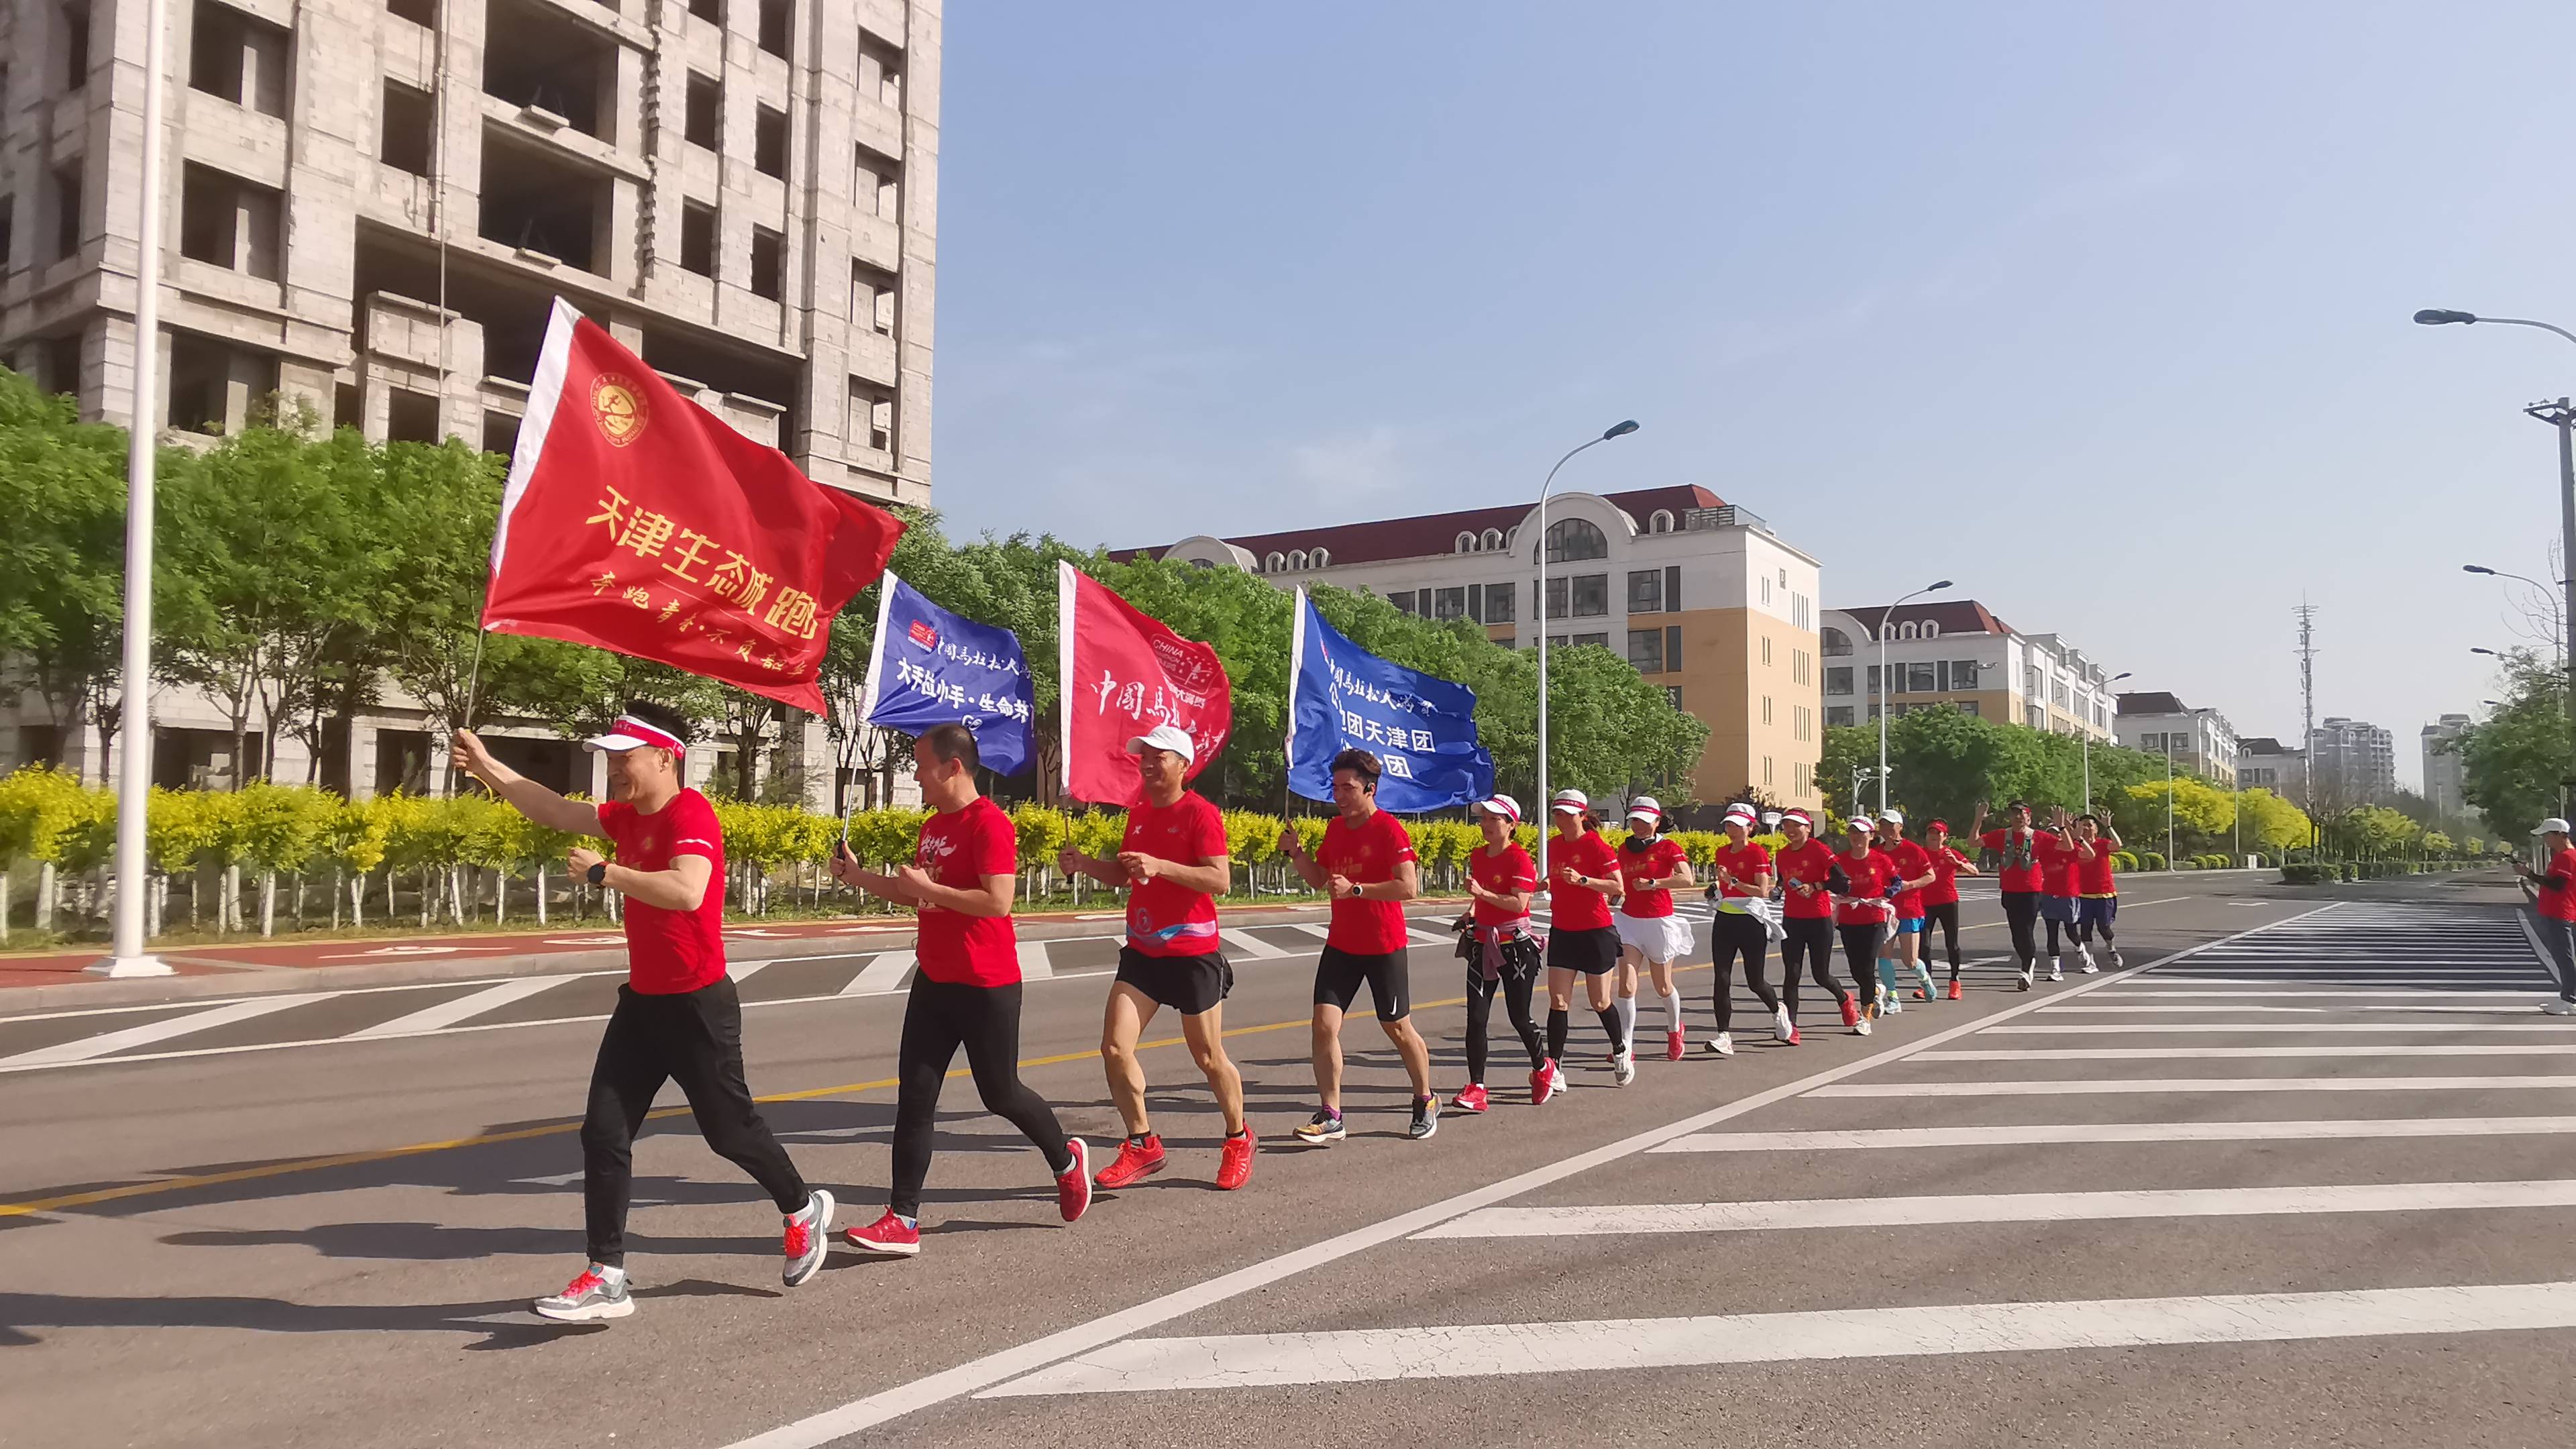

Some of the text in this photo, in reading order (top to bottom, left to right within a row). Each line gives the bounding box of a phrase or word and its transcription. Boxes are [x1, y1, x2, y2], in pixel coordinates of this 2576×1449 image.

[1153, 639, 1183, 658] CHINA
[896, 657, 1034, 724] 大手拉小手·生命共
